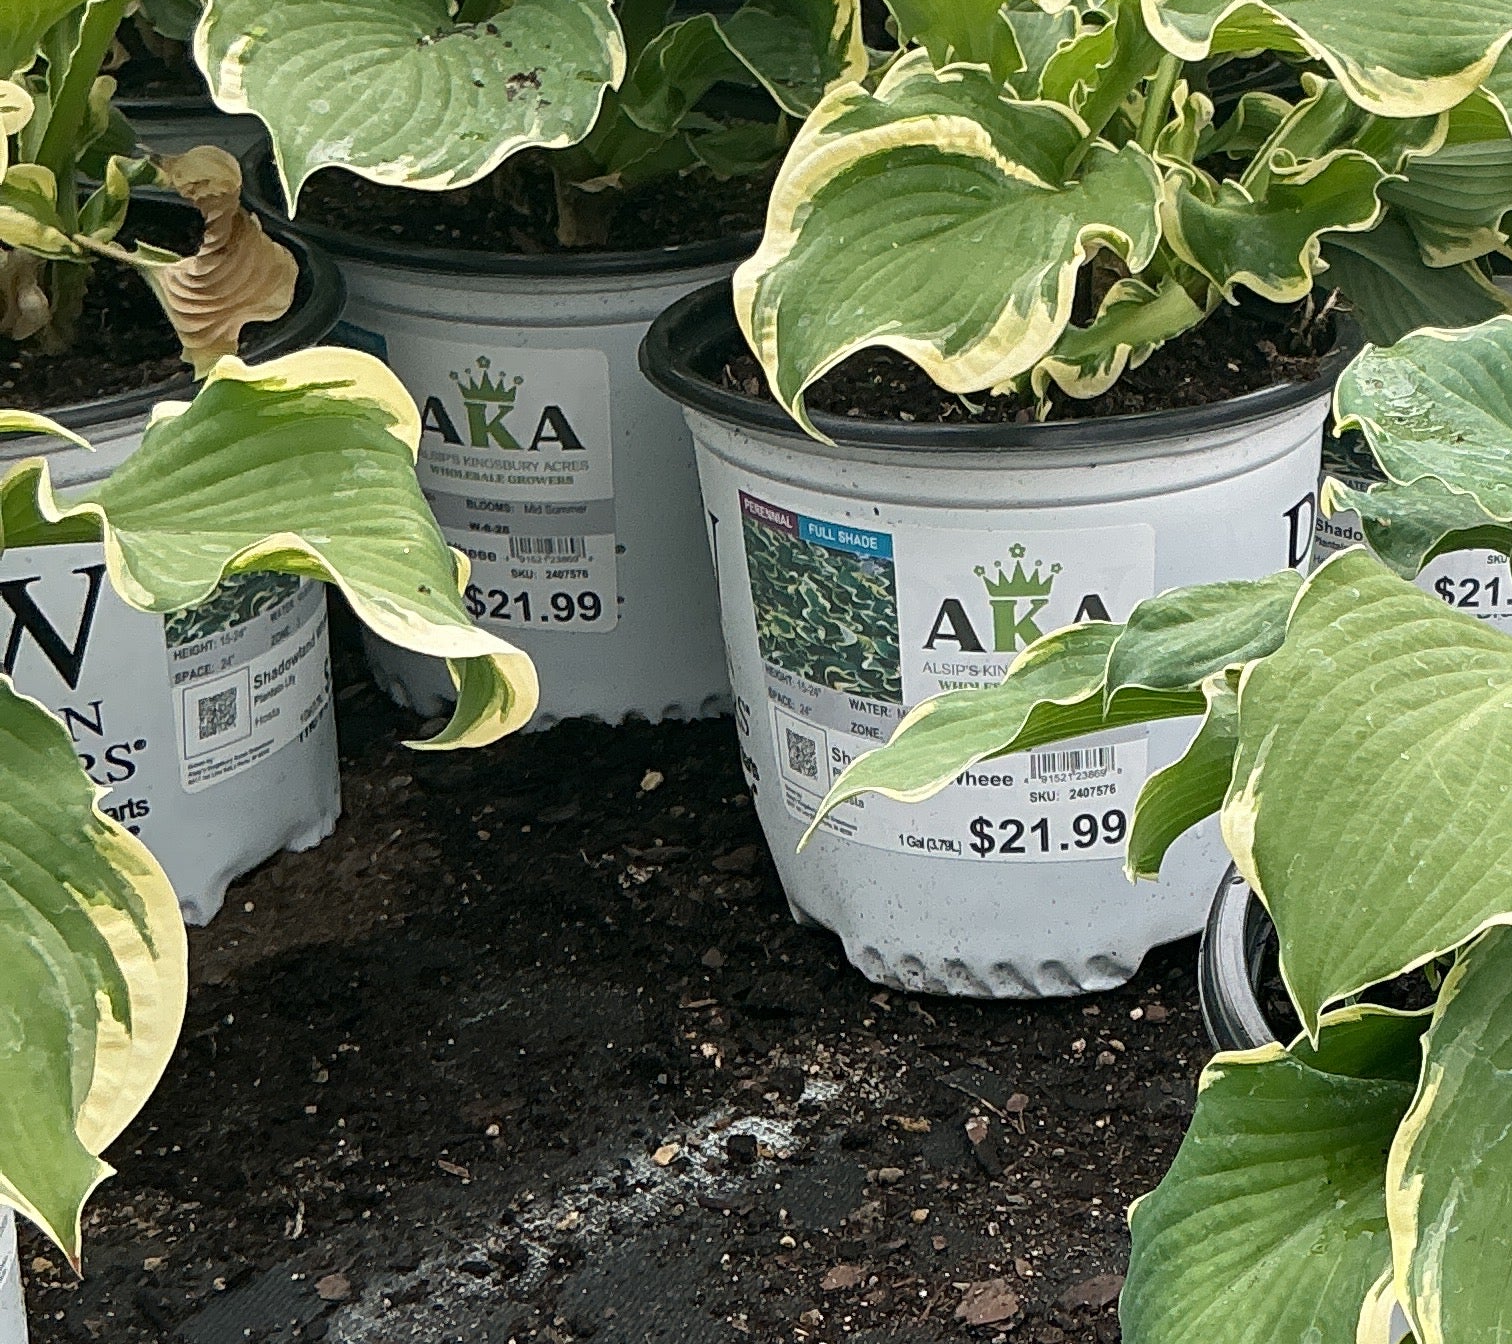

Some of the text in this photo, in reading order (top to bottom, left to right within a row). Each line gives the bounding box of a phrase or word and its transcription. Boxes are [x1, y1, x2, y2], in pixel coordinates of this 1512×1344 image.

[421, 395, 587, 451] AKA
[463, 455, 540, 472] KINGSBURY
[543, 459, 590, 472] ACRES
[506, 474, 575, 486] GROWERS
[743, 497, 878, 550] PERENNIAL FULL SHADE
[464, 583, 603, 623] $21.99
[922, 661, 981, 677] ALSIP'S
[848, 697, 892, 718] WATER:
[850, 721, 884, 739] ZONE:
[1029, 783, 1117, 803] SKU: 2407576
[969, 808, 1128, 858] $21.99
